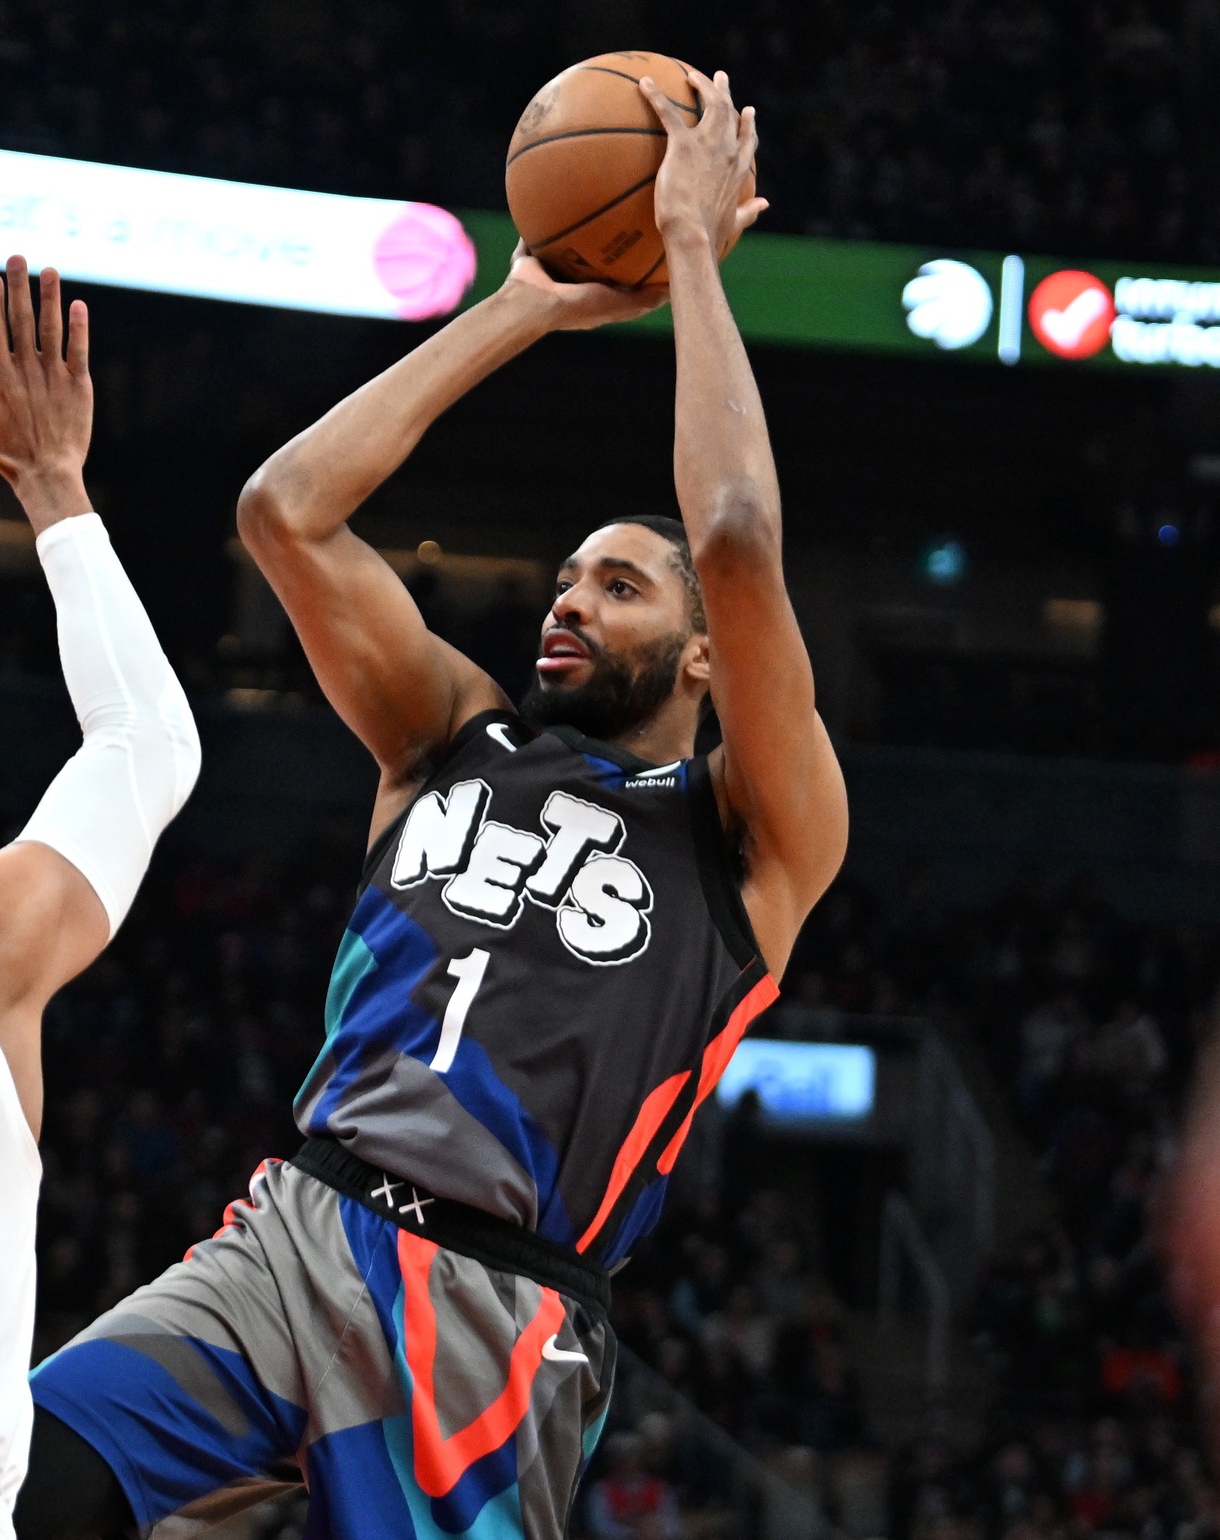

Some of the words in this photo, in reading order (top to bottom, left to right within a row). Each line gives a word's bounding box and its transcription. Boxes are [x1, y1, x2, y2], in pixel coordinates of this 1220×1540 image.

[103, 210, 132, 246] a
[390, 778, 654, 966] NETS
[429, 947, 491, 1073] 1
